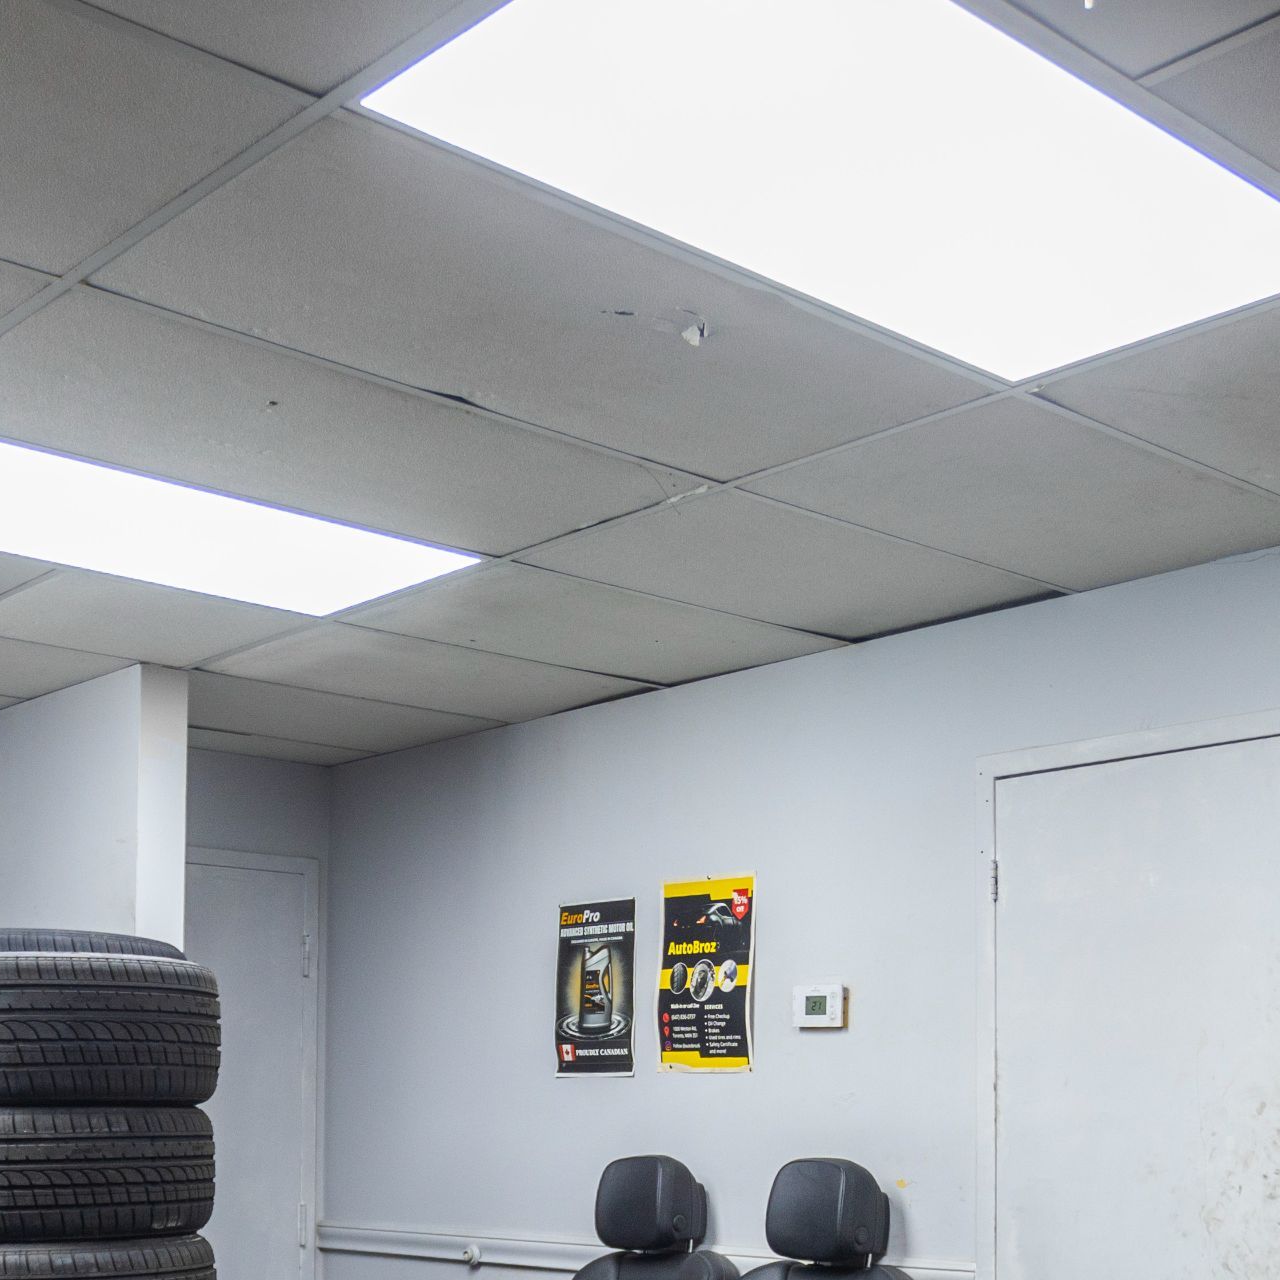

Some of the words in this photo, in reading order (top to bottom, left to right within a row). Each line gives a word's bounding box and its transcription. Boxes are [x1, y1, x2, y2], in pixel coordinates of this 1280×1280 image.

[561, 909, 600, 925] EuroPro
[667, 940, 717, 956] AutoBroz
[600, 1048, 628, 1056] CANADIAN
